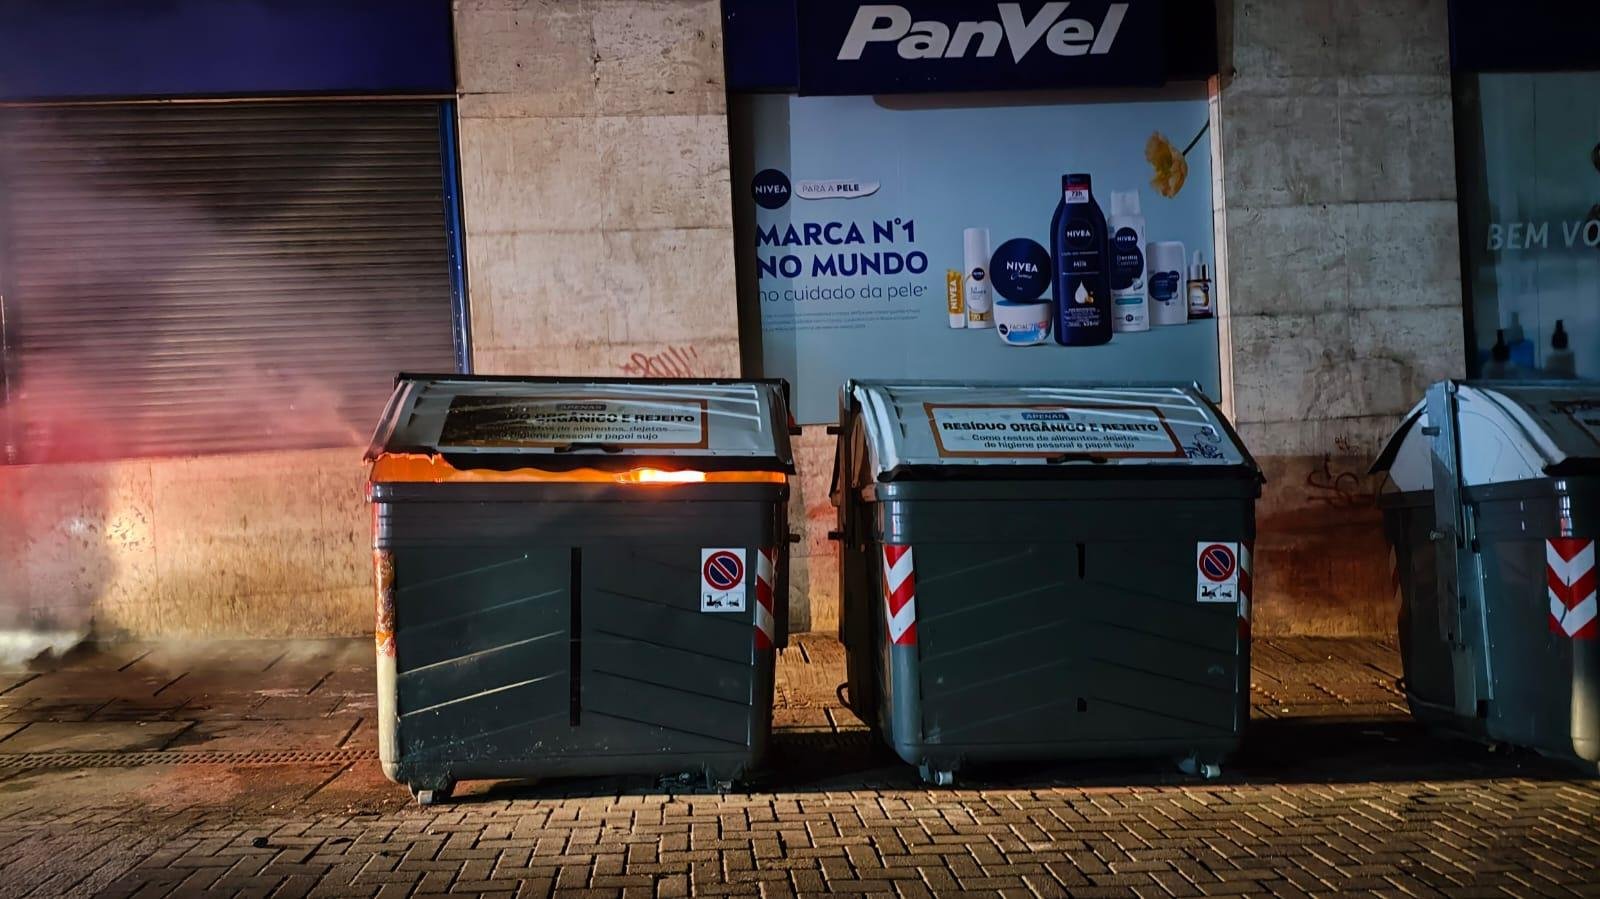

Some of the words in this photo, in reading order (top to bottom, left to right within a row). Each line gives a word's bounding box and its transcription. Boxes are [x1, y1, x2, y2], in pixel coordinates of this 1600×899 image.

[836, 2, 1129, 64] PanVel
[755, 184, 788, 194] NIVEA
[802, 184, 826, 193] PARA
[827, 184, 834, 192] A
[836, 183, 860, 192] PELE
[755, 221, 865, 247] MARCA
[1488, 221, 1548, 249] BEM
[757, 254, 802, 279] NO
[812, 251, 928, 277] MUNDO
[1006, 261, 1038, 272] NIVEA
[759, 289, 779, 302] no
[784, 284, 855, 301] cuidado
[860, 284, 882, 298] da
[949, 280, 958, 310] NIVEA
[621, 413, 632, 423] E
[634, 414, 695, 422] REJEITO
[1026, 412, 1065, 420] APENAS
[943, 421, 1007, 431] RESÍDUO
[1010, 421, 1086, 433] ORGÂNICO
[1089, 422, 1100, 432] E
[1101, 423, 1158, 432] REJEITO
[551, 432, 593, 440] pessoal
[1103, 434, 1140, 443] dejetos
[1085, 441, 1112, 449] papel
[1114, 441, 1135, 449] sujo
